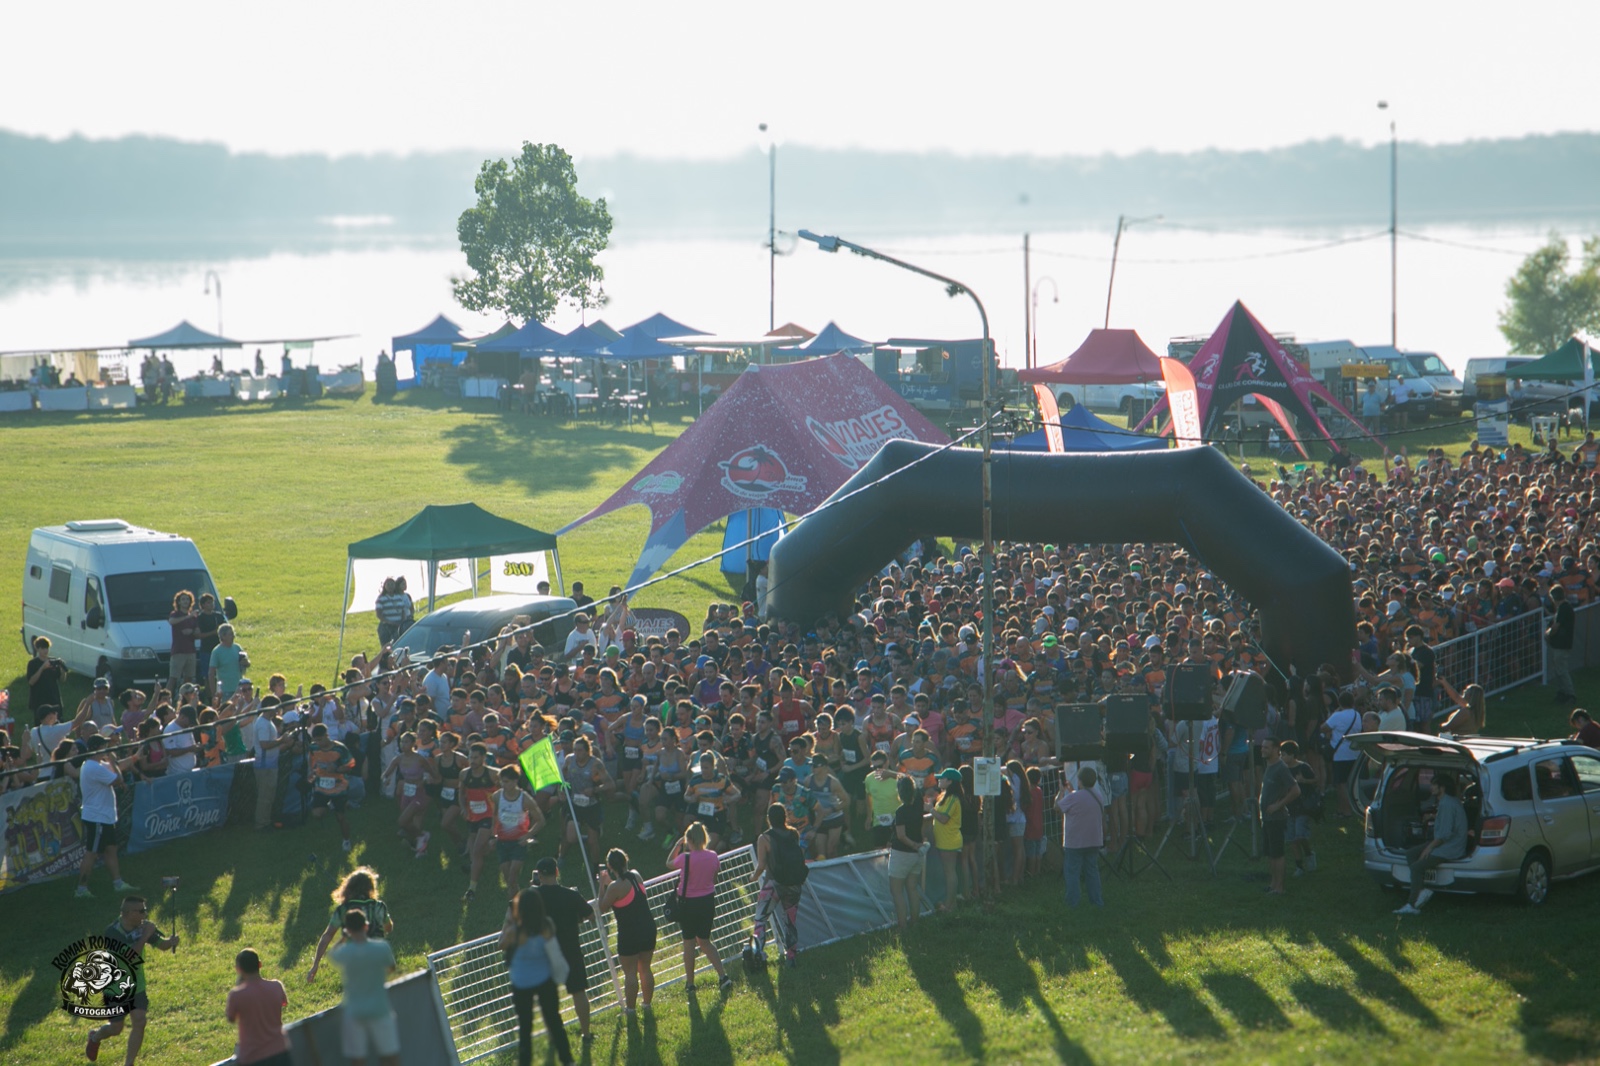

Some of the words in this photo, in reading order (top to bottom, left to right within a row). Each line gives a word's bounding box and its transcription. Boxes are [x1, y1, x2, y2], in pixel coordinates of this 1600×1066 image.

[827, 409, 902, 445] VIAJES
[635, 617, 675, 628] IAJES
[144, 813, 181, 840] Doña
